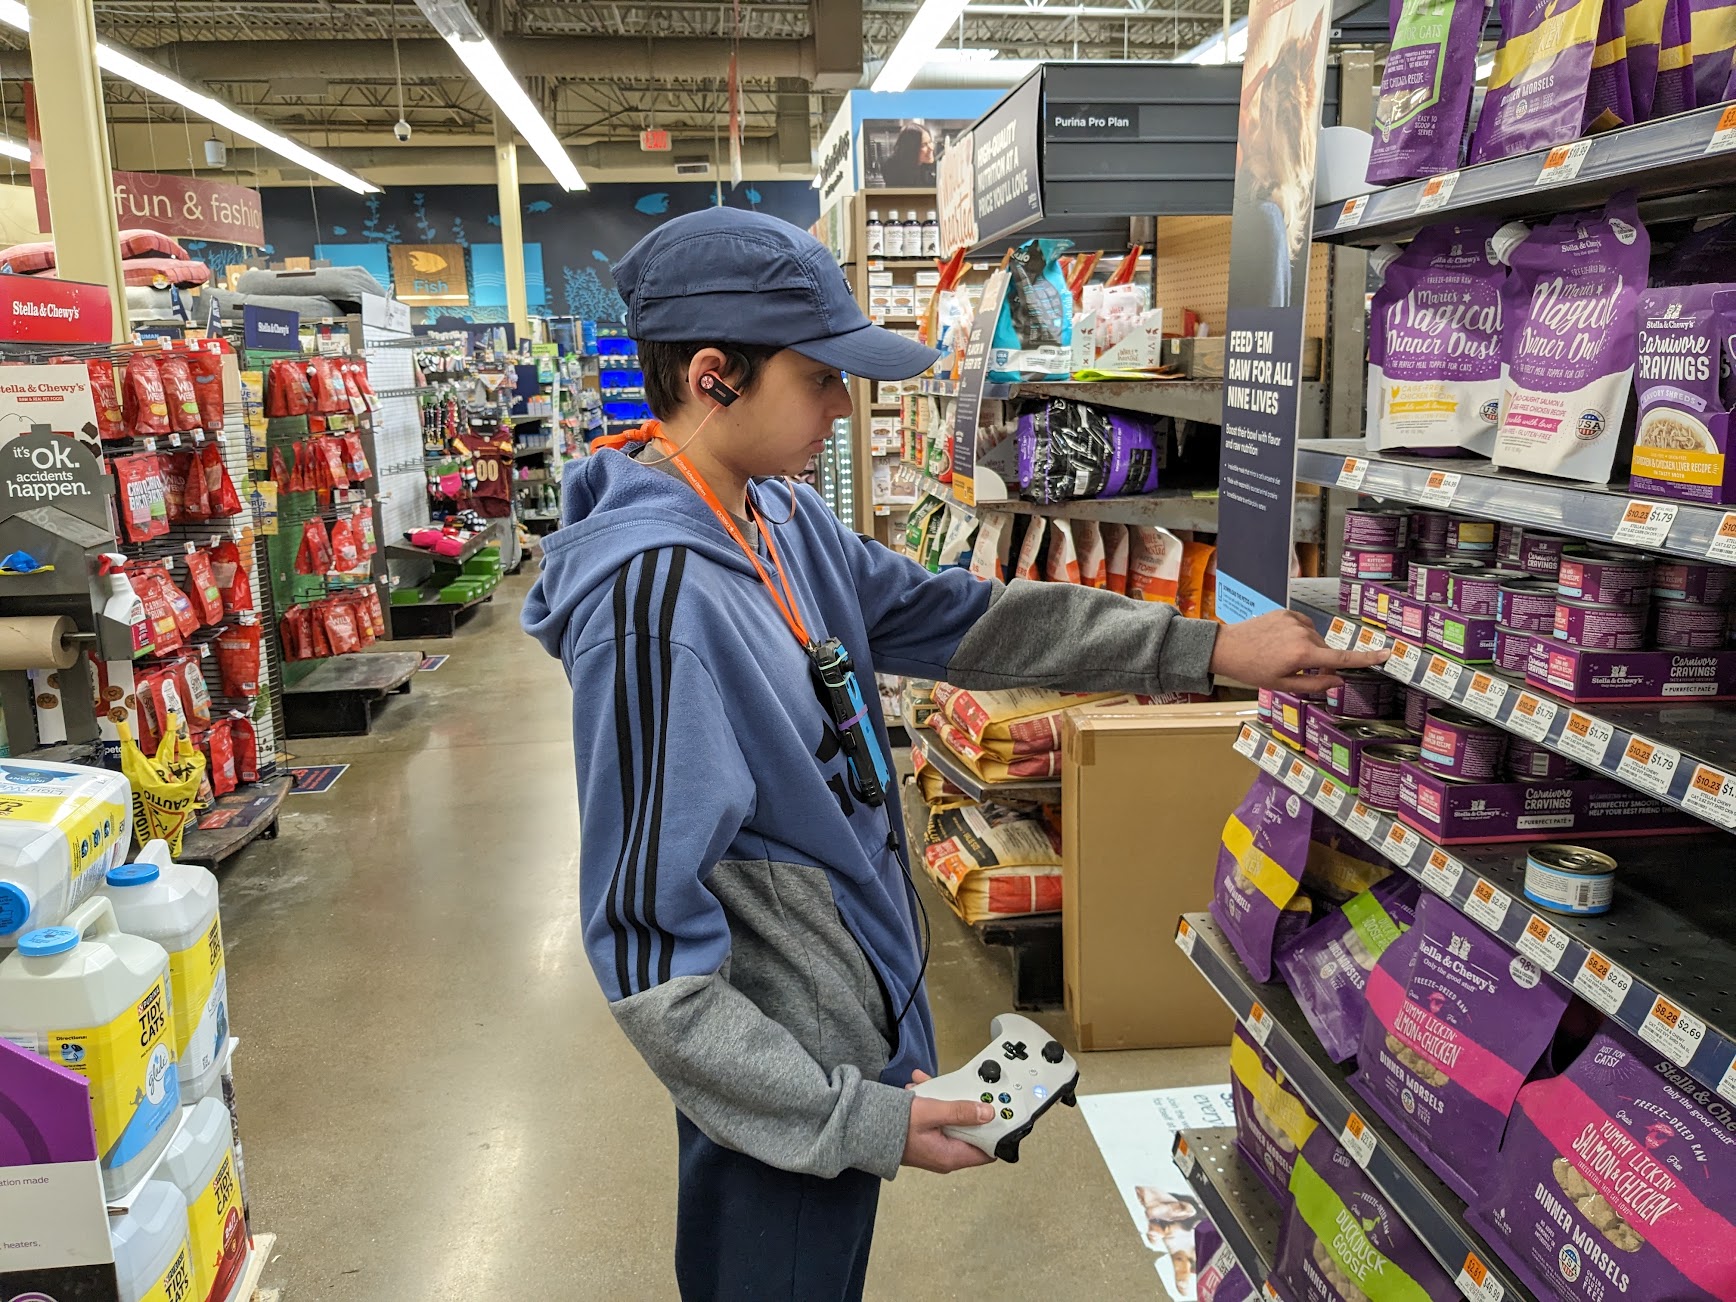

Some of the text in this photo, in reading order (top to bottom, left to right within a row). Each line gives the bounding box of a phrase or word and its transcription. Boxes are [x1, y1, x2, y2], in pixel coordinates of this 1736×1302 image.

[1419, 24, 1442, 40] CATS
[1408, 72, 1425, 84] RECIPE
[1521, 75, 1555, 98] MORSELS
[1055, 116, 1129, 127] Purina Pro Plan
[979, 195, 993, 218] PRICE
[1012, 169, 1028, 197] LOVE
[114, 185, 261, 229] fun & fashio
[413, 279, 448, 293] Fish
[1427, 276, 1460, 284] FREEZE-DRIED
[13, 301, 80, 322] Stella & Chewy's
[1646, 321, 1694, 330] Stella Chewy's
[1230, 331, 1273, 354] FEED 'EM
[1387, 330, 1501, 360] Dinner Dust
[1518, 327, 1566, 360] Dinner
[1639, 331, 1710, 354] Carnivore
[1229, 358, 1293, 387] RAW FOR ALL
[1429, 361, 1446, 369] TOPPER
[1448, 362, 1458, 370] FOR
[1639, 355, 1710, 381] CRAVINGS
[0, 383, 85, 394] tella & Chewy's
[1665, 389, 1696, 404] SHREDS
[1227, 386, 1279, 415] NINE LIVES
[1226, 423, 1238, 436] Boost
[1579, 421, 1601, 430] USA
[13, 440, 80, 470] it's ok.
[1241, 442, 1258, 456] nutrition
[16, 471, 73, 482] accidents
[476, 459, 499, 481] 00
[1656, 459, 1712, 474] CHICKEN LIVER RECIPE
[6, 480, 91, 501] happen.
[1627, 509, 1673, 523] $10.23 $1.79
[1527, 560, 1557, 570] CRAVINGS
[1528, 551, 1558, 561] Carnivore
[1405, 650, 1418, 661] $1.79
[1672, 656, 1718, 667] Carnivore
[1445, 667, 1459, 679] $1.79
[1617, 677, 1643, 685] Chewy's
[1671, 666, 1716, 677] CRAVINGS
[1489, 684, 1505, 697] $1.79
[1519, 700, 1553, 719] $10.23 $1.79
[1569, 719, 1609, 742] $10.23 $1.79
[1629, 745, 1673, 770] $10.23 $1.79
[1526, 788, 1572, 800] Carnivore
[1696, 775, 1720, 790] $10.23
[1525, 799, 1571, 810] CRAVINGS
[1606, 807, 1622, 815] YOUR
[1638, 806, 1660, 814] FRIEND
[132, 791, 151, 842] UIDADO
[1445, 864, 1460, 877] $2.69
[1476, 885, 1507, 911] $8.28 $2.69
[1529, 921, 1564, 951] $8.28 $2.69
[1338, 954, 1365, 990] MORSELS
[1423, 959, 1476, 993] Only the good stuff
[1442, 955, 1452, 967] &
[1452, 958, 1496, 994] Chewy's
[1520, 957, 1536, 974] 98%
[1588, 957, 1628, 991] $8.28 $2.69
[143, 984, 160, 1008] PURINA
[1414, 976, 1468, 1014] FREEZE-DRIED RAW
[139, 996, 161, 1030] TIDY
[1402, 1000, 1427, 1023] YUMMY
[1655, 1003, 1701, 1040] $8.28 $2.69
[140, 1011, 165, 1047] CATS
[1420, 1035, 1461, 1069] CHICKEN
[1594, 1053, 1620, 1068] CATS!
[1599, 1045, 1626, 1060] JUST FOR
[1380, 1050, 1445, 1114] DINNER MORSELS
[1654, 1061, 1709, 1105] Stella &
[1663, 1085, 1734, 1146] Only the good stuff
[1616, 1110, 1682, 1171] Grain Free
[1634, 1098, 1708, 1163] FREEZE-DRIED RAW
[1333, 1153, 1351, 1168] CATS!
[1600, 1120, 1677, 1192] YUMMY LICKIN'
[0, 1176, 49, 1187] ation made
[215, 1167, 231, 1200] TIDY
[1572, 1123, 1678, 1226] SALMON & CHICKEN
[217, 1181, 233, 1216] CATS
[1360, 1192, 1387, 1221] FREEZE-DRIED
[3, 1240, 41, 1249] heaters.
[1336, 1209, 1387, 1275] DUCK DUCK
[1535, 1182, 1630, 1293] DINNER MORSELS
[1332, 1235, 1366, 1282] GOOSE
[1561, 1250, 1579, 1276] USA
[165, 1261, 186, 1300] TIDY
[1303, 1258, 1327, 1299] DINNER
[1483, 1277, 1500, 1301] $46.99
[1585, 1275, 1604, 1298] GLUTEN
